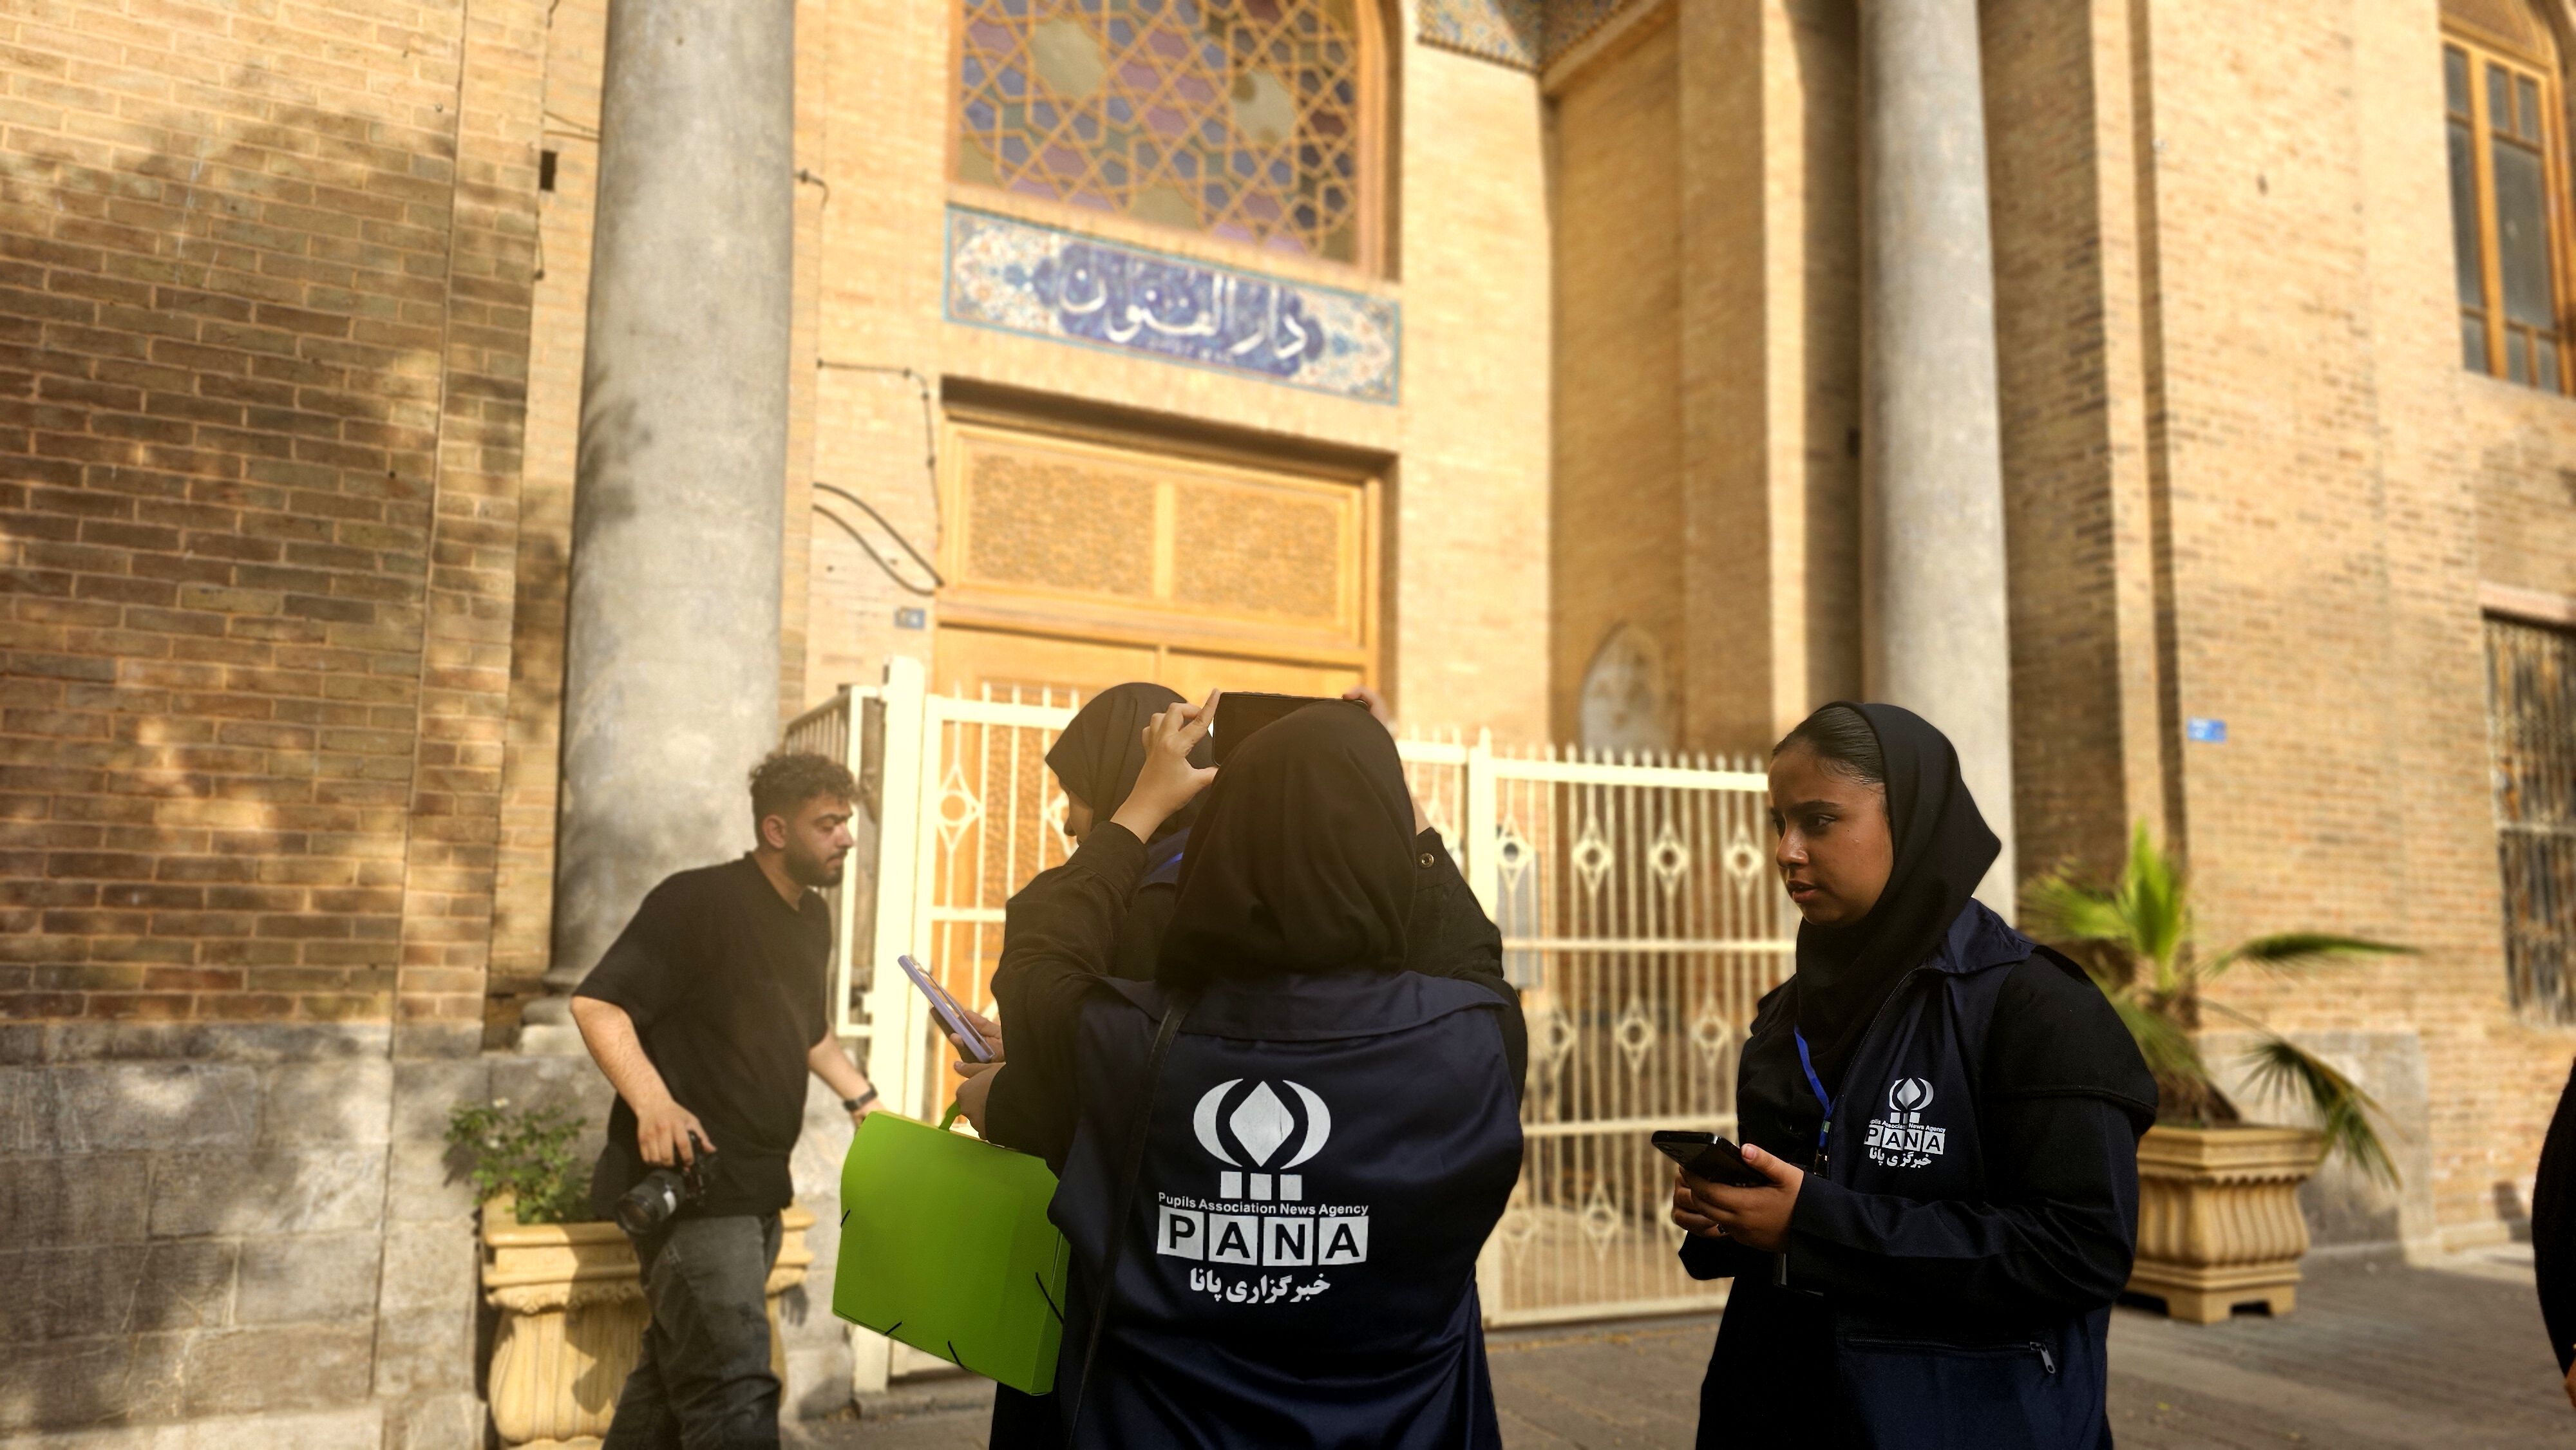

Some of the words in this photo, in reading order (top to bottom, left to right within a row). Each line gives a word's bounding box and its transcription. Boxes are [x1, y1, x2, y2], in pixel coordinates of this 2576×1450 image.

[1059, 267, 1238, 344] الفنون
[1229, 283, 1309, 359] دار
[1865, 1126, 1942, 1153] PANA
[1926, 1125, 1946, 1135] Agency
[1869, 1147, 1885, 1166] پانا
[1159, 1192, 1196, 1209] Pupils
[1198, 1198, 1276, 1214] Association
[1280, 1203, 1316, 1216] News
[1318, 1203, 1369, 1218] Agency
[1167, 1212, 1361, 1261] PANA
[1189, 1267, 1222, 1302] پانا
[1226, 1272, 1331, 1304] خبرگزاری
